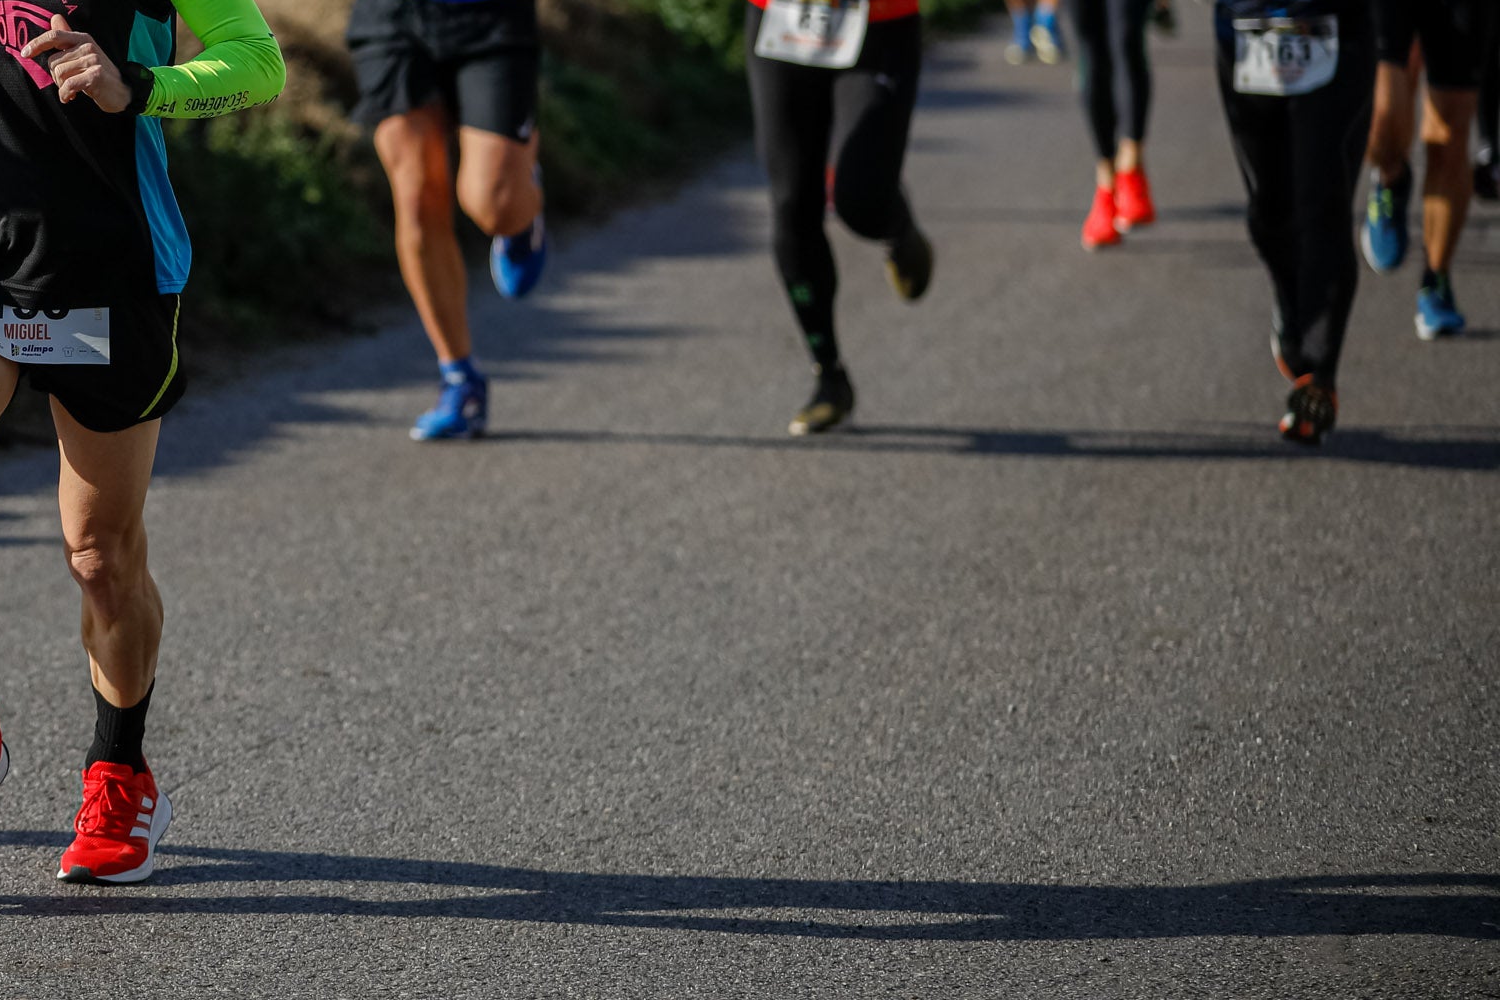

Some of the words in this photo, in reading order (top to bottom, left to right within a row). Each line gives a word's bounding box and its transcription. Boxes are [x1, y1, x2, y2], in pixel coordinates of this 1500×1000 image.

[184, 90, 249, 111] SECADEROS
[3, 323, 52, 340] MIGUEL
[21, 345, 54, 354] olimpo
